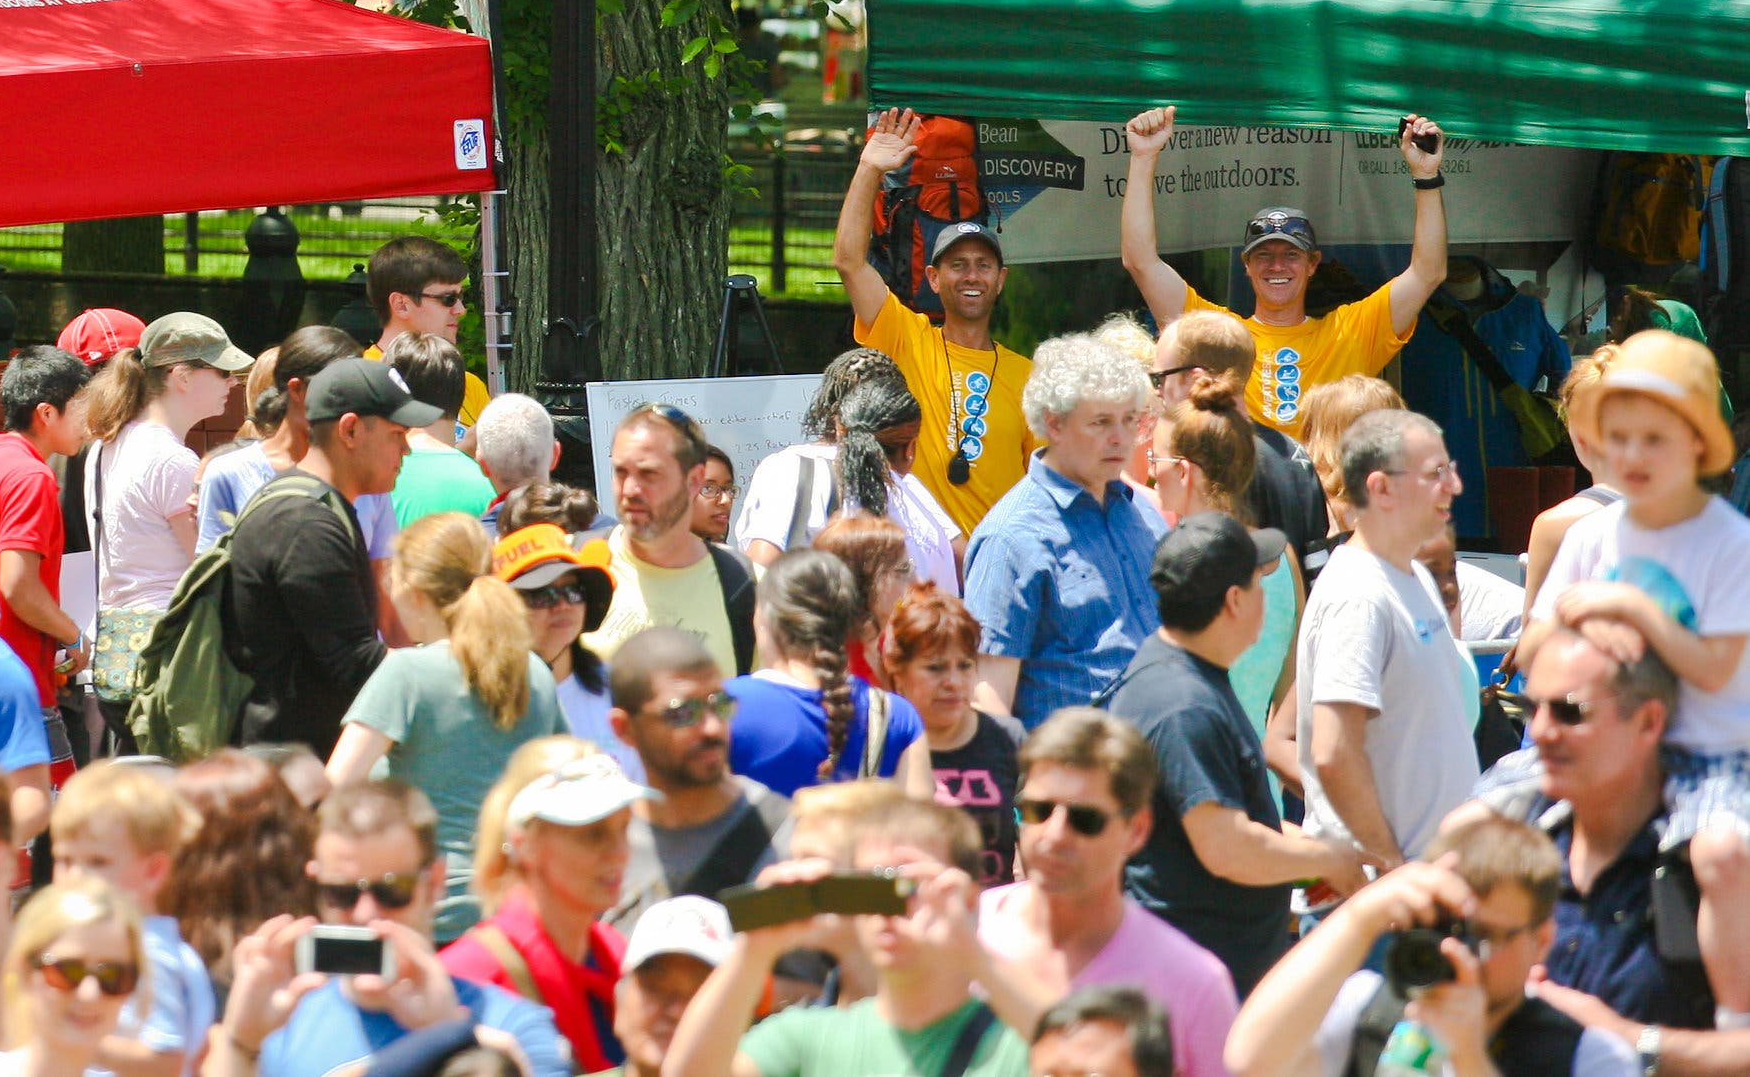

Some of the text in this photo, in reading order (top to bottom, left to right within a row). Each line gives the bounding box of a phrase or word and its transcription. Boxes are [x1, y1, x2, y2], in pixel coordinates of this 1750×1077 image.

[979, 123, 1018, 144] Bean
[1100, 126, 1195, 155] Diver
[1204, 125, 1243, 147] new
[1244, 123, 1333, 145] reason
[984, 159, 1077, 180] DISCOVERY
[1180, 164, 1201, 193] the
[1204, 159, 1301, 191] outdoors.
[986, 190, 1021, 203] OOLS
